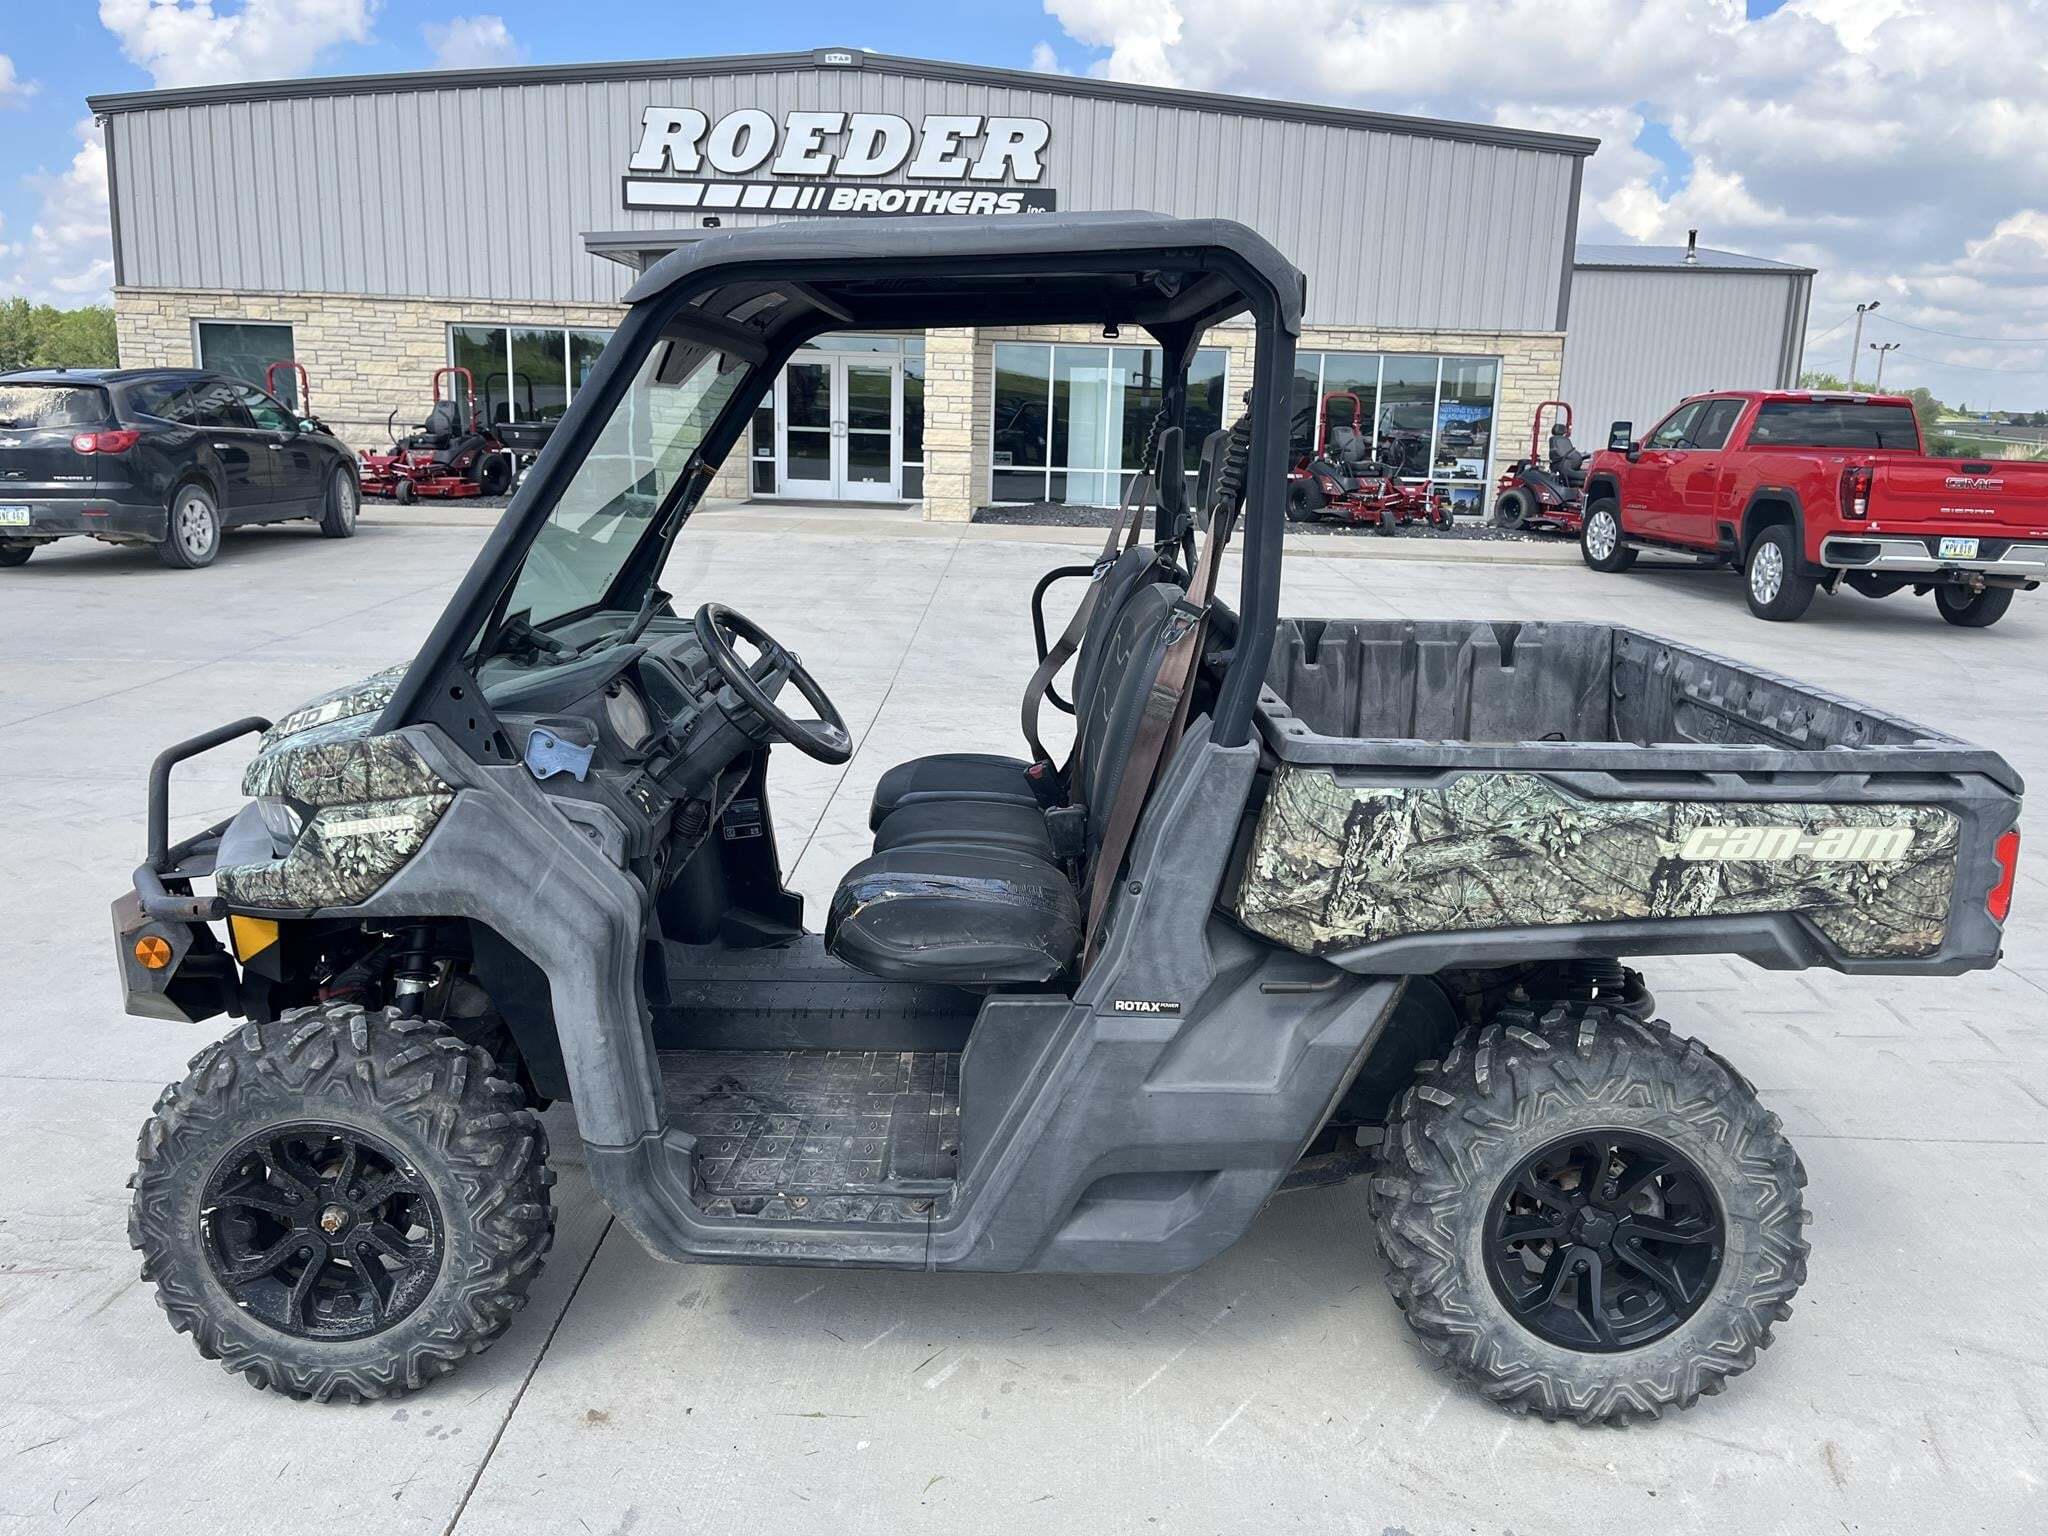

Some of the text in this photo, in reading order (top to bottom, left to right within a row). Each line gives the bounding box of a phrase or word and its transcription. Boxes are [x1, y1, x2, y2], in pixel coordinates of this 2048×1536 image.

[629, 106, 1051, 183] ROEDER
[828, 187, 1024, 215] BROTHERS
[1945, 477, 2004, 491] GMC
[326, 815, 415, 837] DEFENDER
[386, 827, 414, 838] XT
[1115, 1000, 1160, 1012] ROTAX
